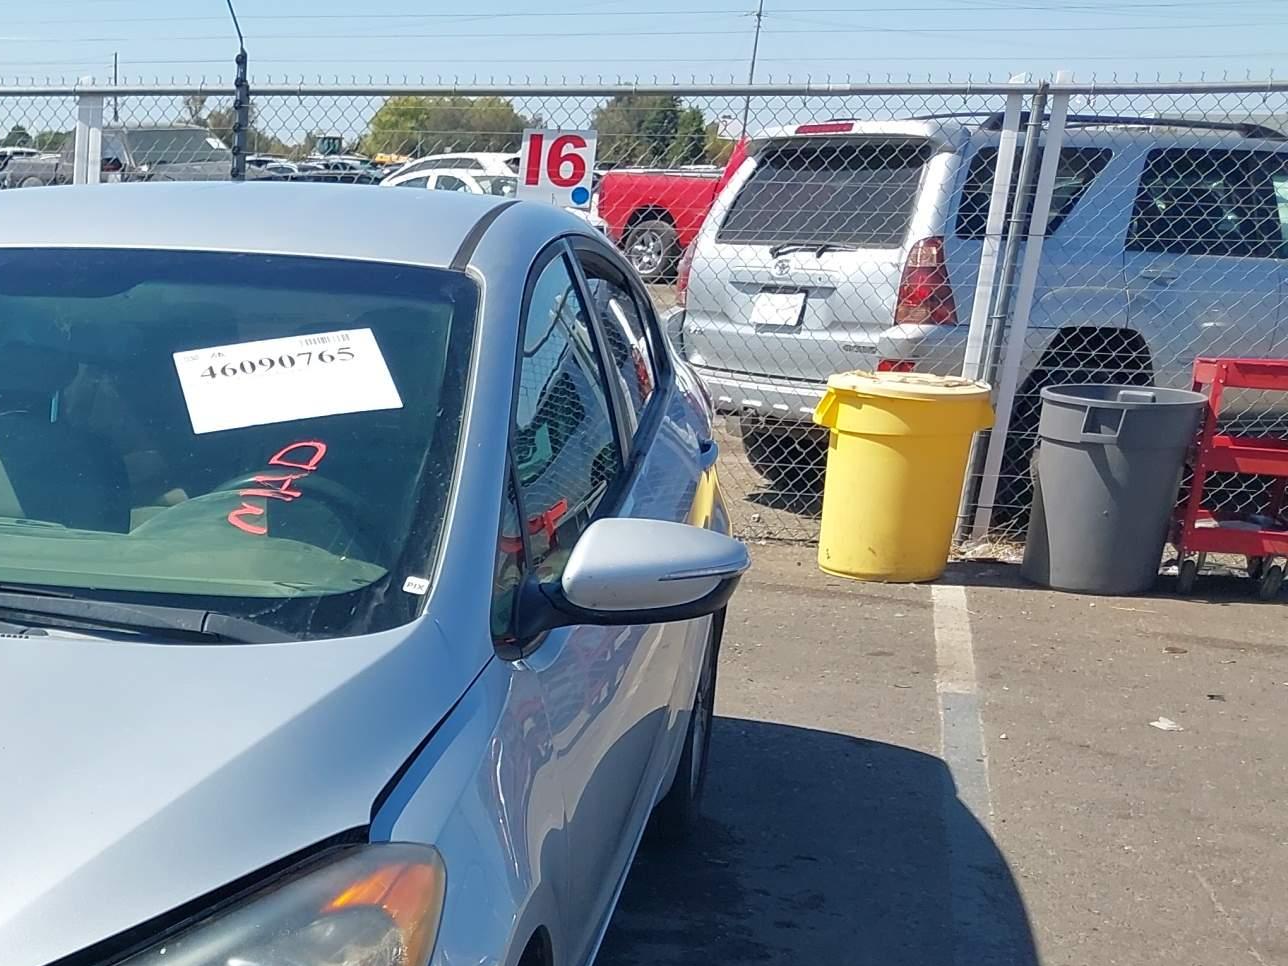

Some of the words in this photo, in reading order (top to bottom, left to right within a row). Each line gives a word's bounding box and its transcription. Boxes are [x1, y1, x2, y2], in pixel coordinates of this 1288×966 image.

[525, 134, 587, 187] 16
[200, 346, 356, 380] 46090765
[406, 581, 425, 591] PIX
